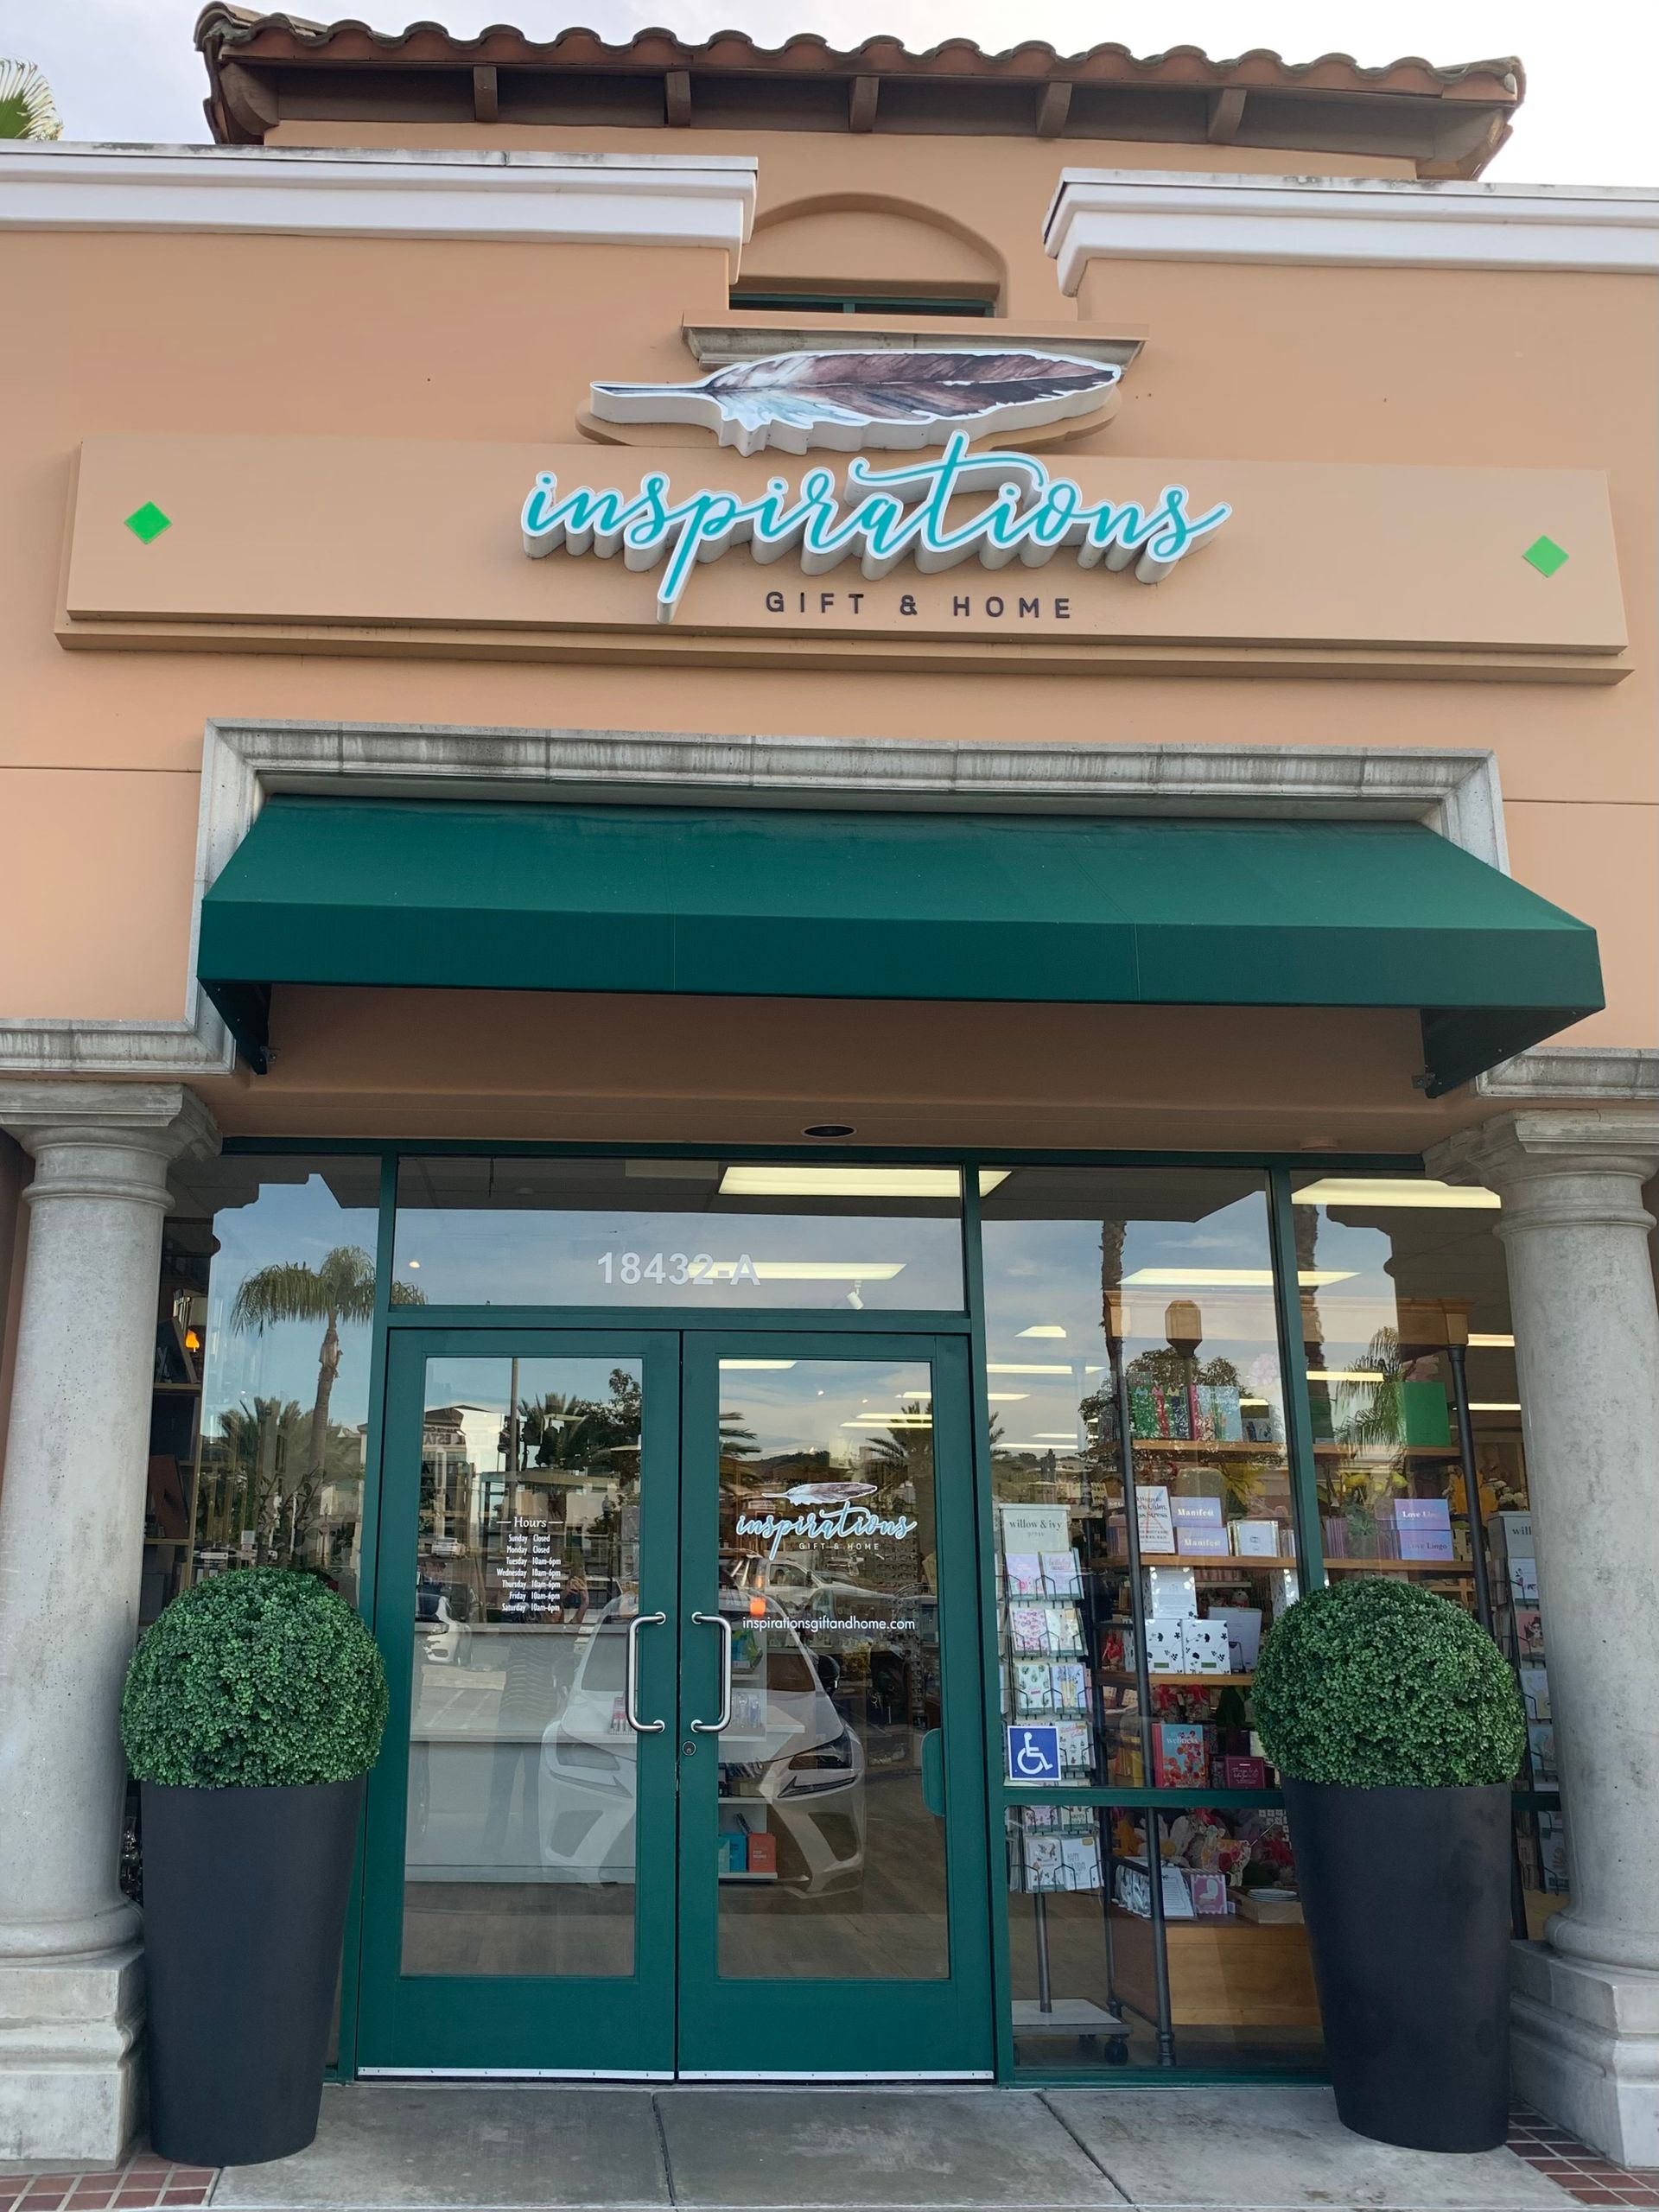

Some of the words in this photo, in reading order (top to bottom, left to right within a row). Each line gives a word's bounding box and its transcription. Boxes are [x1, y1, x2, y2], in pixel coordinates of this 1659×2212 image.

[522, 429, 1233, 608] inspirations
[766, 591, 864, 614] GIFT
[899, 594, 918, 616] &
[953, 596, 1071, 619] HOME
[597, 1252, 761, 1286] 18432-A
[1177, 1508, 1215, 1516] Manifest
[513, 1516, 547, 1528] Hours
[1009, 1519, 1038, 1529] willow
[1039, 1520, 1047, 1529] &
[1049, 1520, 1062, 1531] ivy
[736, 1500, 918, 1561] inspirations
[1512, 1525, 1532, 1535] will
[508, 1534, 528, 1544] Sunday
[532, 1534, 550, 1542] Closed
[1184, 1538, 1222, 1547] Manifest
[506, 1546, 528, 1555] Monday
[1427, 1542, 1448, 1551] Lingo
[505, 1557, 528, 1567] Tuesday
[531, 1557, 562, 1567] 10am-6pm
[496, 1568, 527, 1579] Wednesday
[531, 1568, 562, 1579] 10am-6pm
[501, 1580, 527, 1590] Thursday
[531, 1580, 561, 1590] 10am-6pm
[509, 1591, 526, 1601] Friday
[531, 1591, 561, 1601] 10am-6pm
[501, 1603, 526, 1613] Saturday
[531, 1603, 560, 1613] 10am-6pm
[742, 1615, 915, 1633] inspirationsgiftandhome.com
